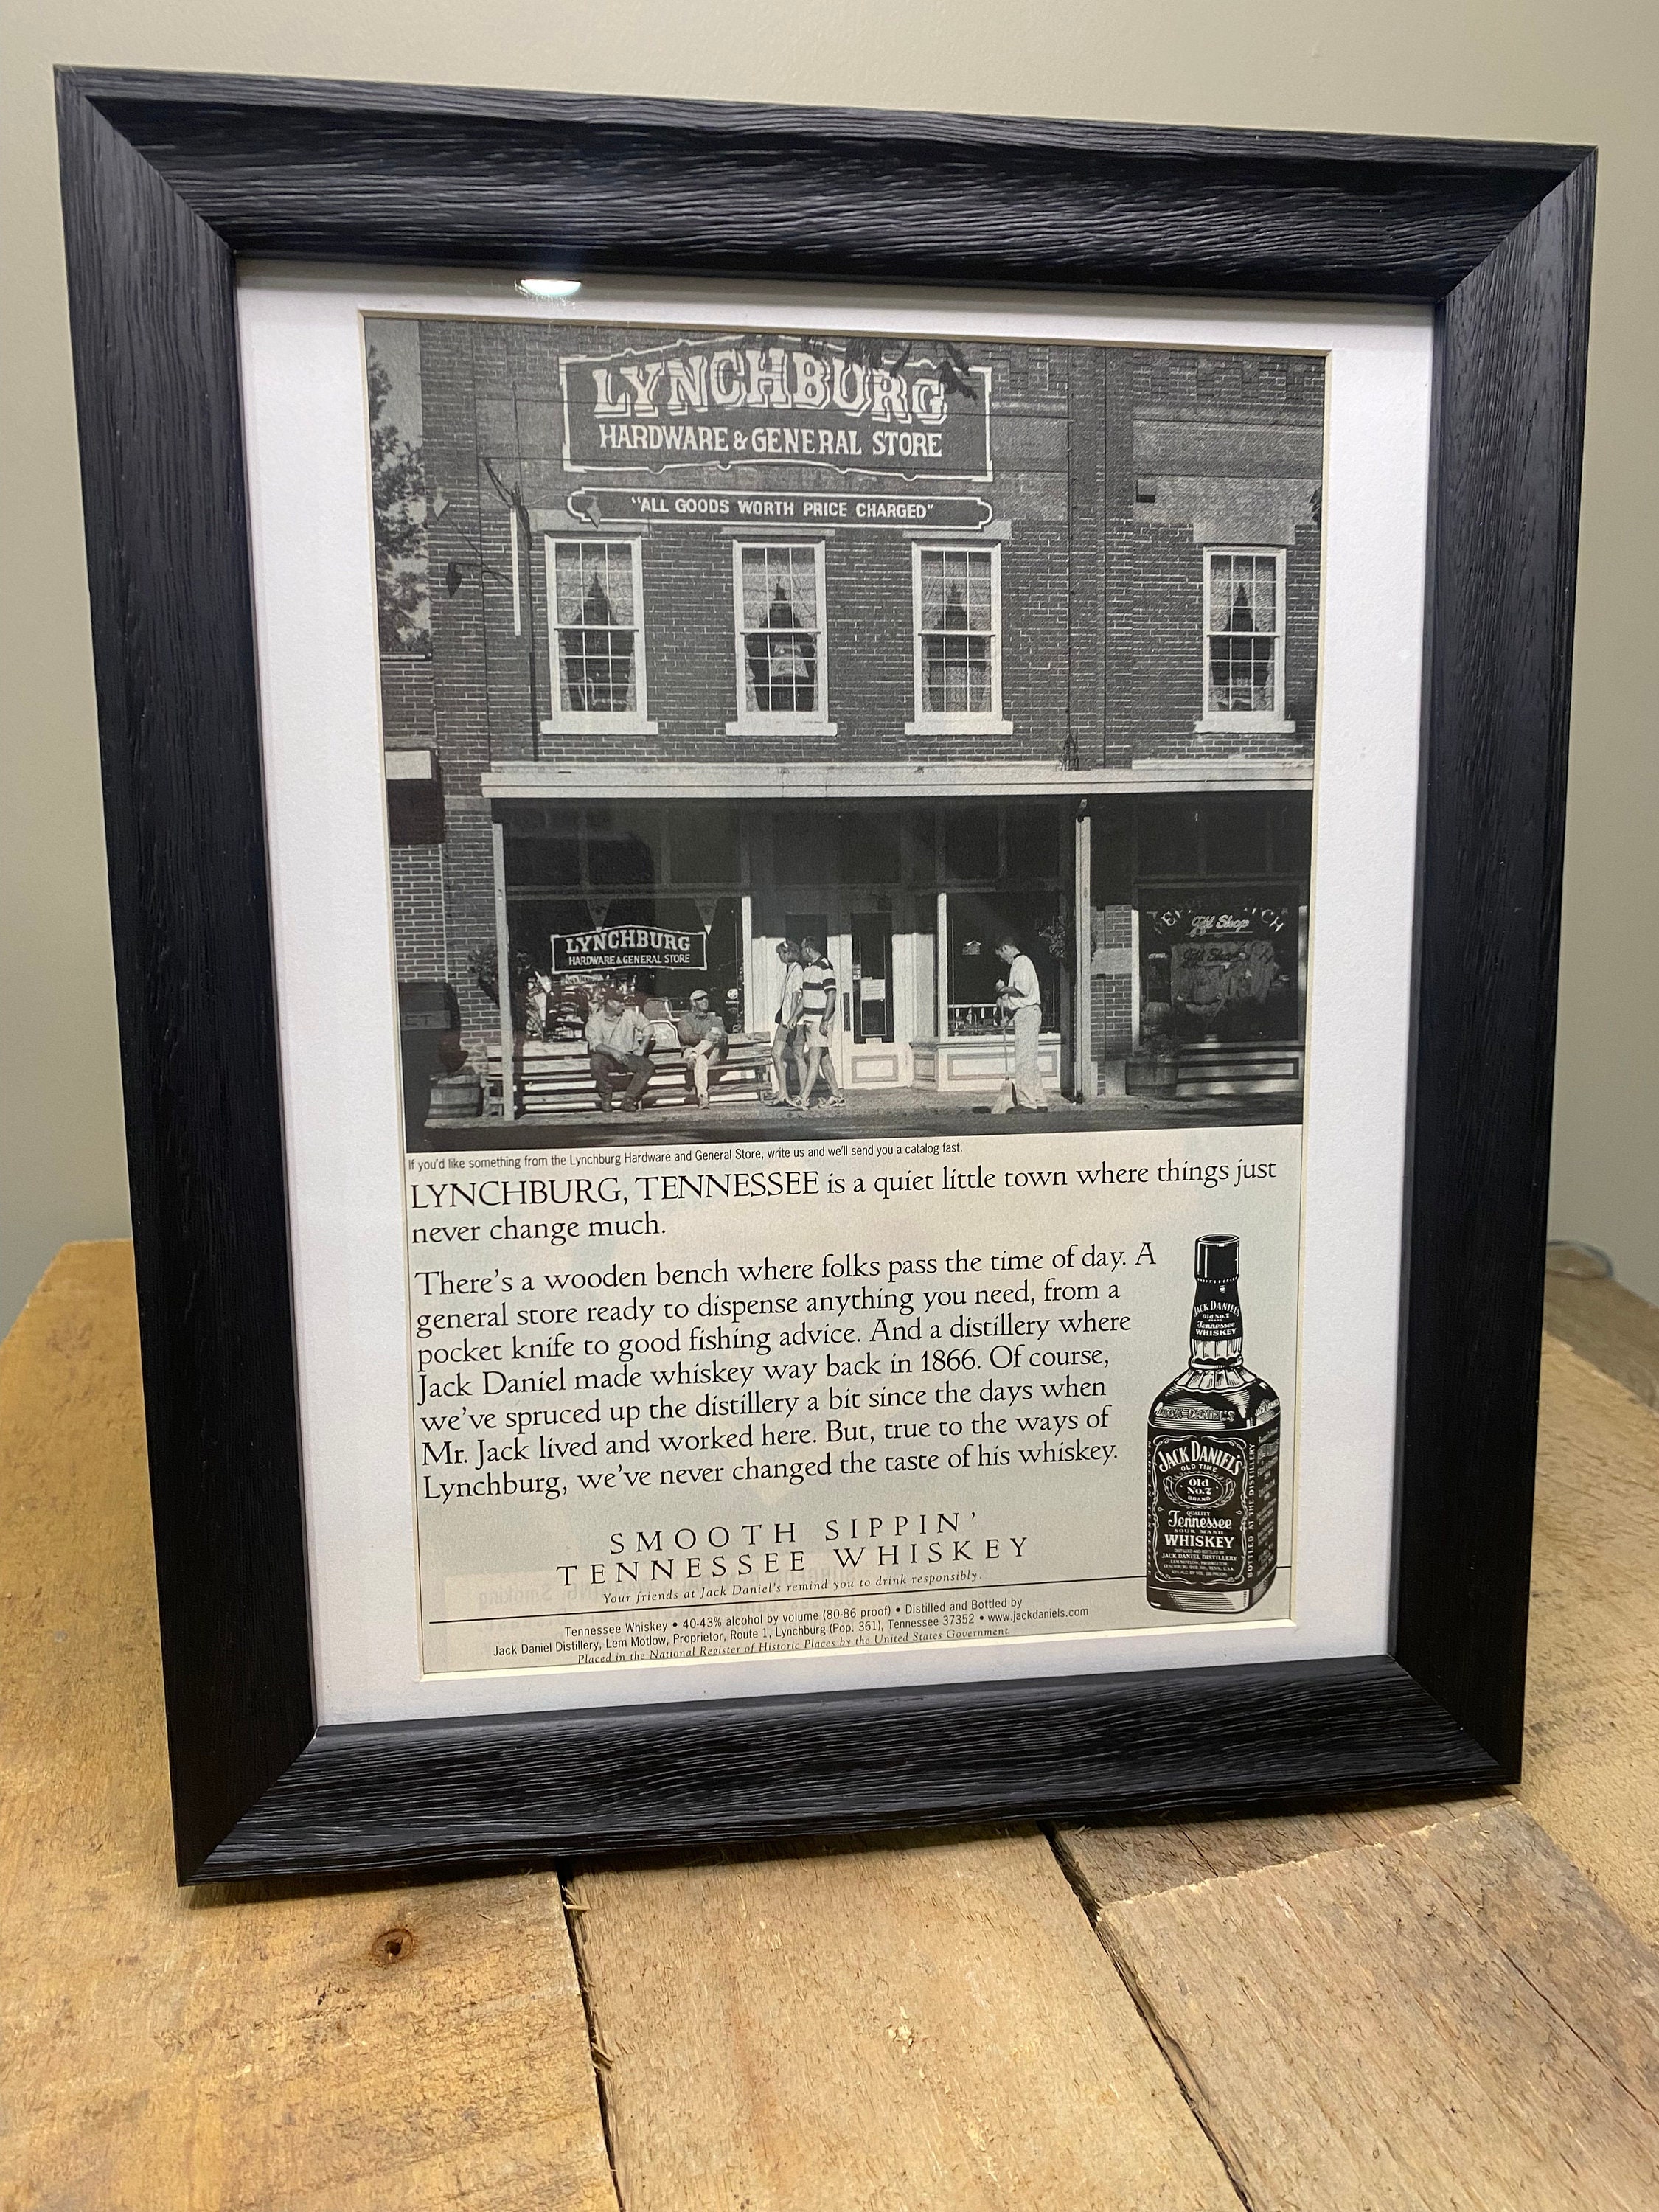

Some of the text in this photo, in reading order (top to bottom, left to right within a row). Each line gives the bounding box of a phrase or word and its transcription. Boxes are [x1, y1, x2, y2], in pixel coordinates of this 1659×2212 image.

[592, 348, 948, 425] LYNCHBURG
[599, 423, 942, 458] HARDWARE & GENERAL STORE
[631, 495, 934, 519] "ALL GOODS WORTH PRICE CHARGED"
[566, 929, 691, 954] LYNCHBURG
[568, 955, 616, 966] HARDWARE
[622, 954, 661, 965] GENERAL
[664, 953, 690, 964] STORE
[408, 1141, 963, 1173] If you'd like something from the Lynchburg Hardware and General Store, write us and we'll send you a catalog fast.
[410, 1158, 1277, 1209] LYNCHBURG, TENNESSEE is a quiet little town where things just
[411, 1210, 666, 1247] never change much.
[414, 1242, 1157, 1296] There's a wooden bench where folks pass the time of day. A
[416, 1277, 1121, 1339] general store ready to dispense anything you need, from a
[1193, 1303, 1209, 1318] JACK
[1197, 1320, 1236, 1329] Tennessee
[1195, 1328, 1237, 1336] WHISKEY
[417, 1343, 1109, 1407] Jack Daniel made whiskey way back in 1866. Of course,
[422, 1437, 1118, 1505] Lynchburg, we've never changed the taste of his whiskey.
[1157, 1440, 1243, 1476] JACK DANIEL'S
[1180, 1463, 1218, 1472] OLD TIME
[1189, 1478, 1209, 1486] Old
[610, 1511, 975, 1555] SMOOTH SIPPIN'
[1167, 1509, 1232, 1529] Tennessee
[1164, 1534, 1235, 1548] WHISKEY
[555, 1537, 1028, 1587] TENNESSEE WHISKEY
[602, 1569, 982, 1604] Your friends at Jack Daniel's remind you to drink responsibly.
[493, 1607, 1089, 1657] Jack Daniel Distillery, Lem Motlow, Proprietor, Route 1, Lynchburg (Pop. 361), Tennessee 37352 www.jackdaniels.com
[564, 1596, 1023, 1638] Tennessee Whiskey 40-43% alcohol by volume (80-86 proof) Distilled and Bottled by
